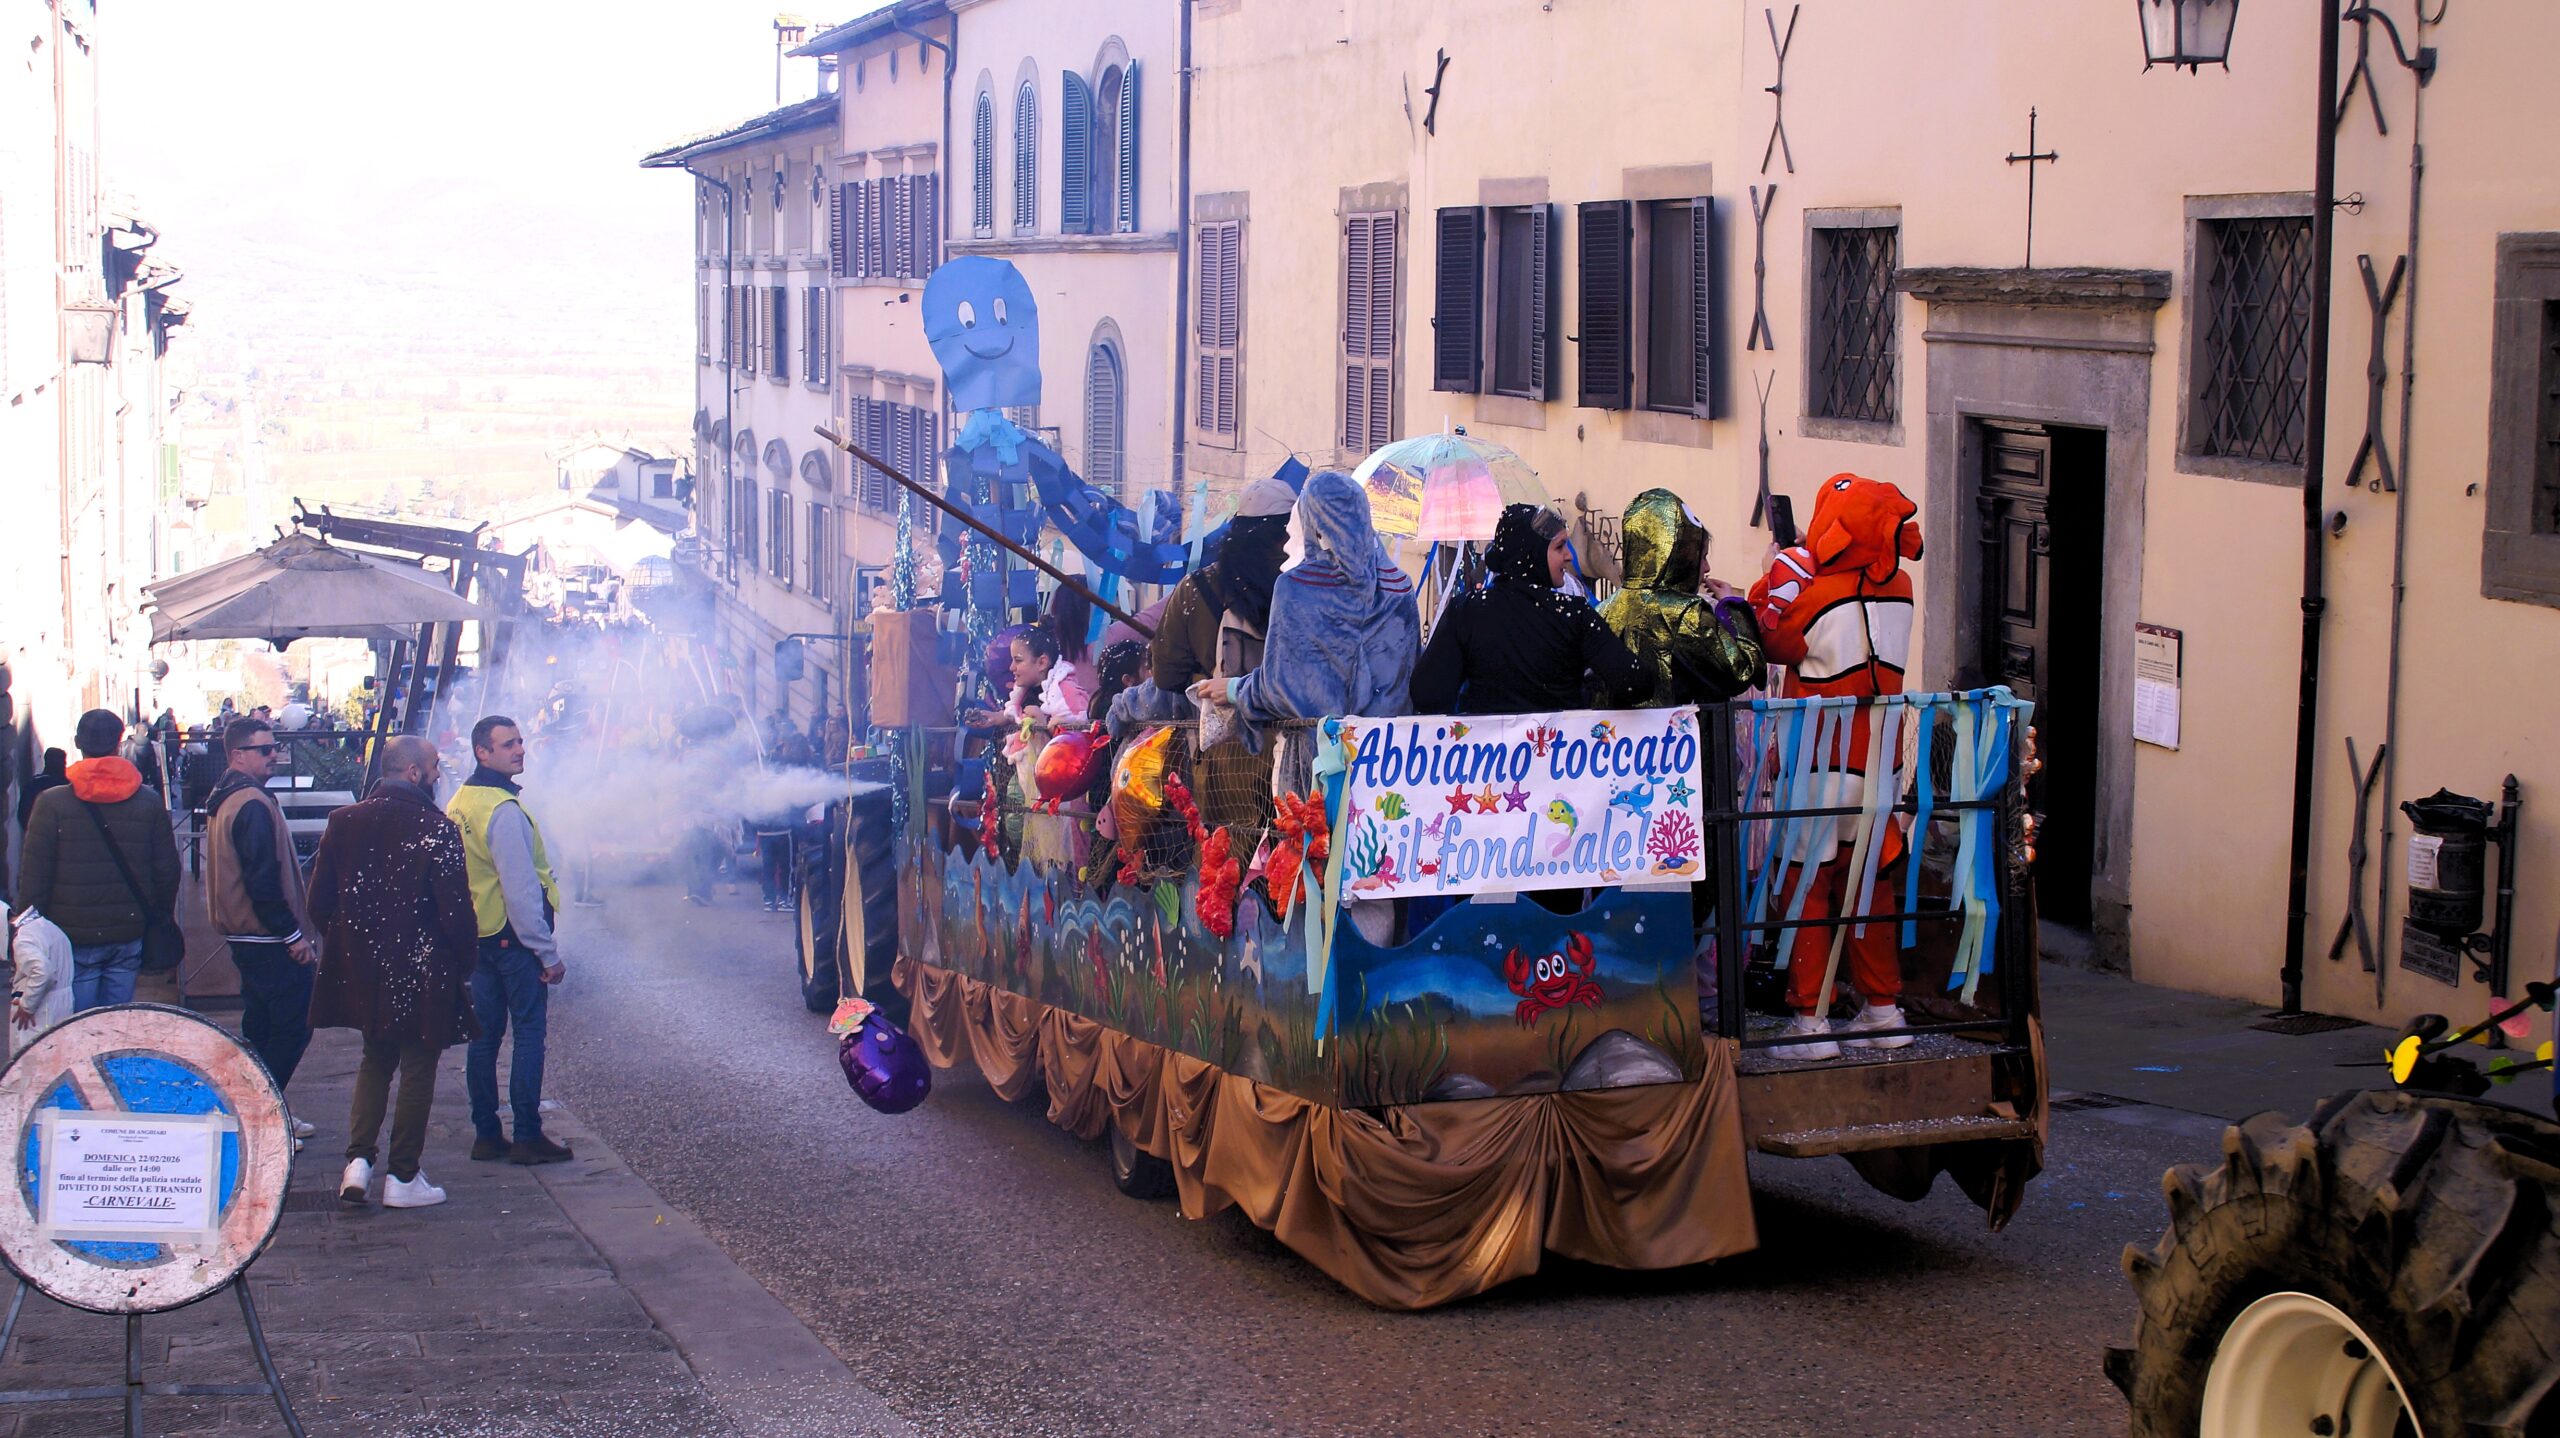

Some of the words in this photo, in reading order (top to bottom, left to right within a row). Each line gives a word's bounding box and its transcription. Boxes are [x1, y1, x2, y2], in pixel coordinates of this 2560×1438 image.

[1351, 722, 1532, 788] Abbiamo
[1550, 725, 1696, 779] toccato
[1397, 817, 1422, 884] il
[84, 1154, 136, 1162] DOMENICA
[139, 1155, 180, 1163] 22/02/2026
[141, 1176, 167, 1184] pulizia
[83, 1196, 176, 1208] -CARNEVALE-
